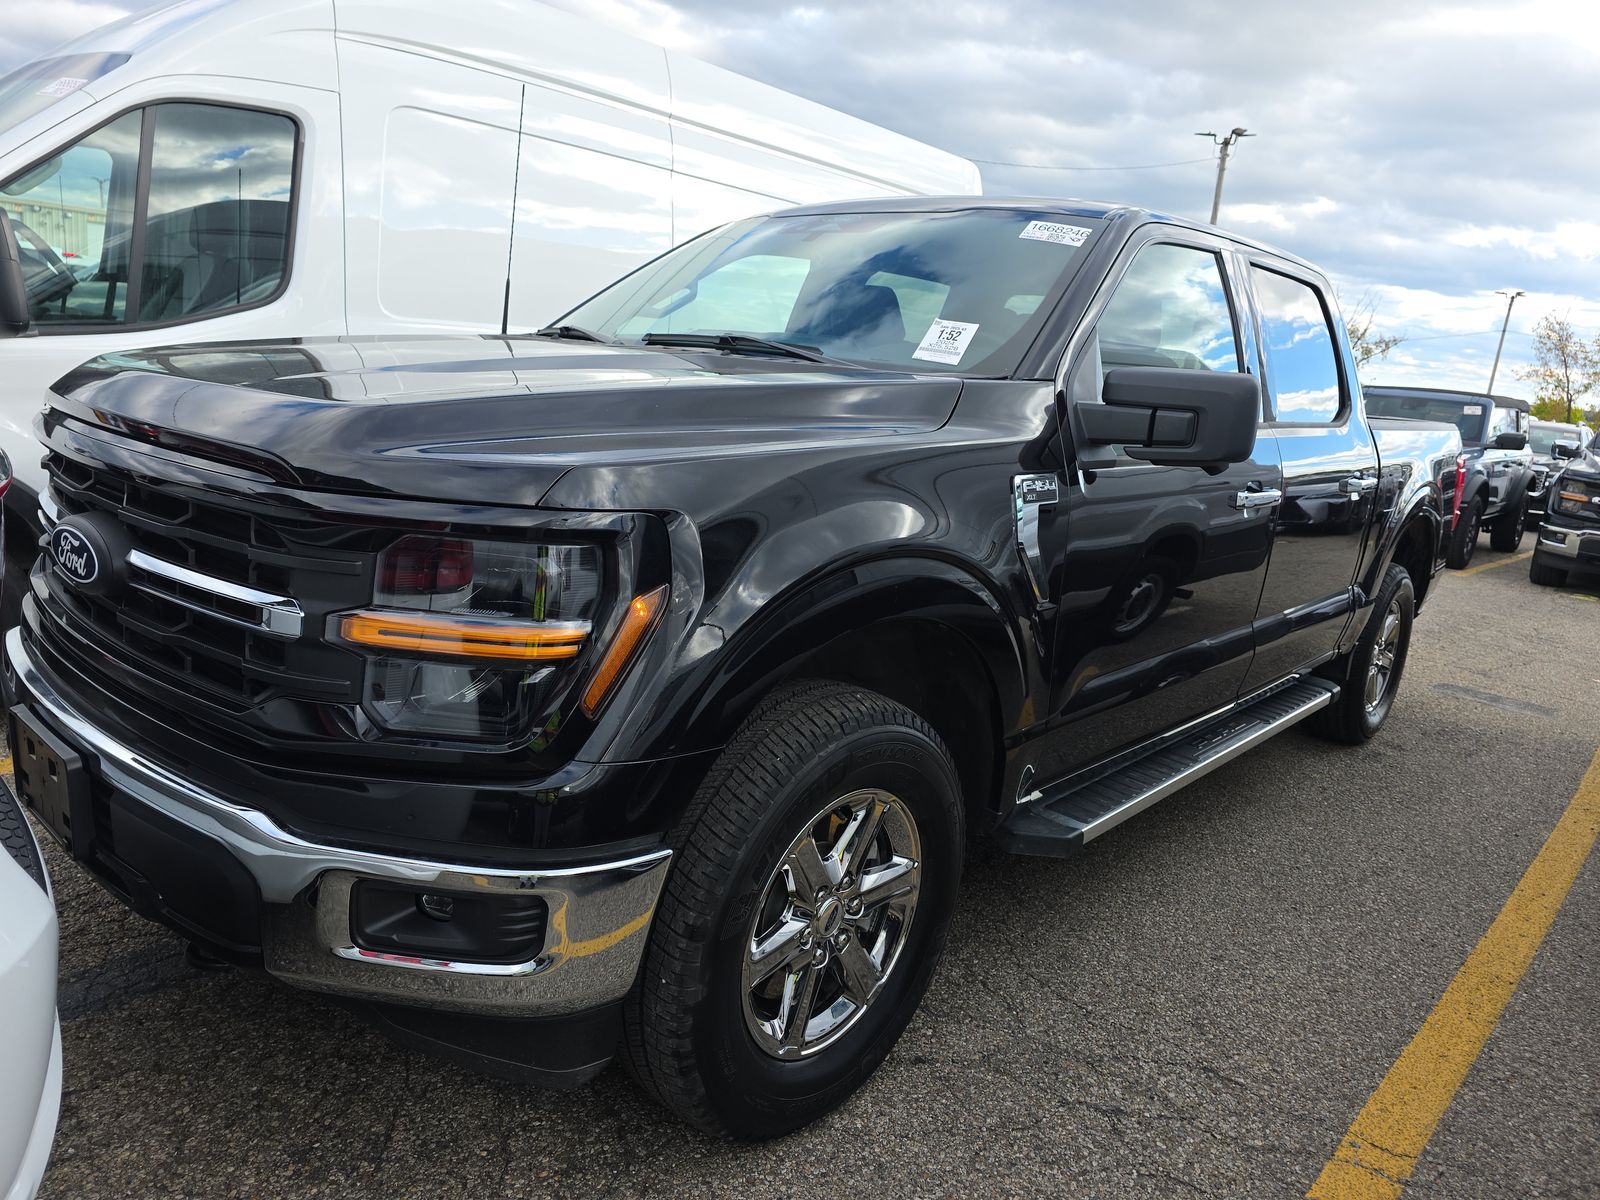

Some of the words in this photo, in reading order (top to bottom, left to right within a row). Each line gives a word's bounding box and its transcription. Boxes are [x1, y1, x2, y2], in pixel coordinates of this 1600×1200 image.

[1032, 223, 1090, 238] 1668246
[938, 328, 962, 341] 1:52
[59, 532, 87, 576] Ford
